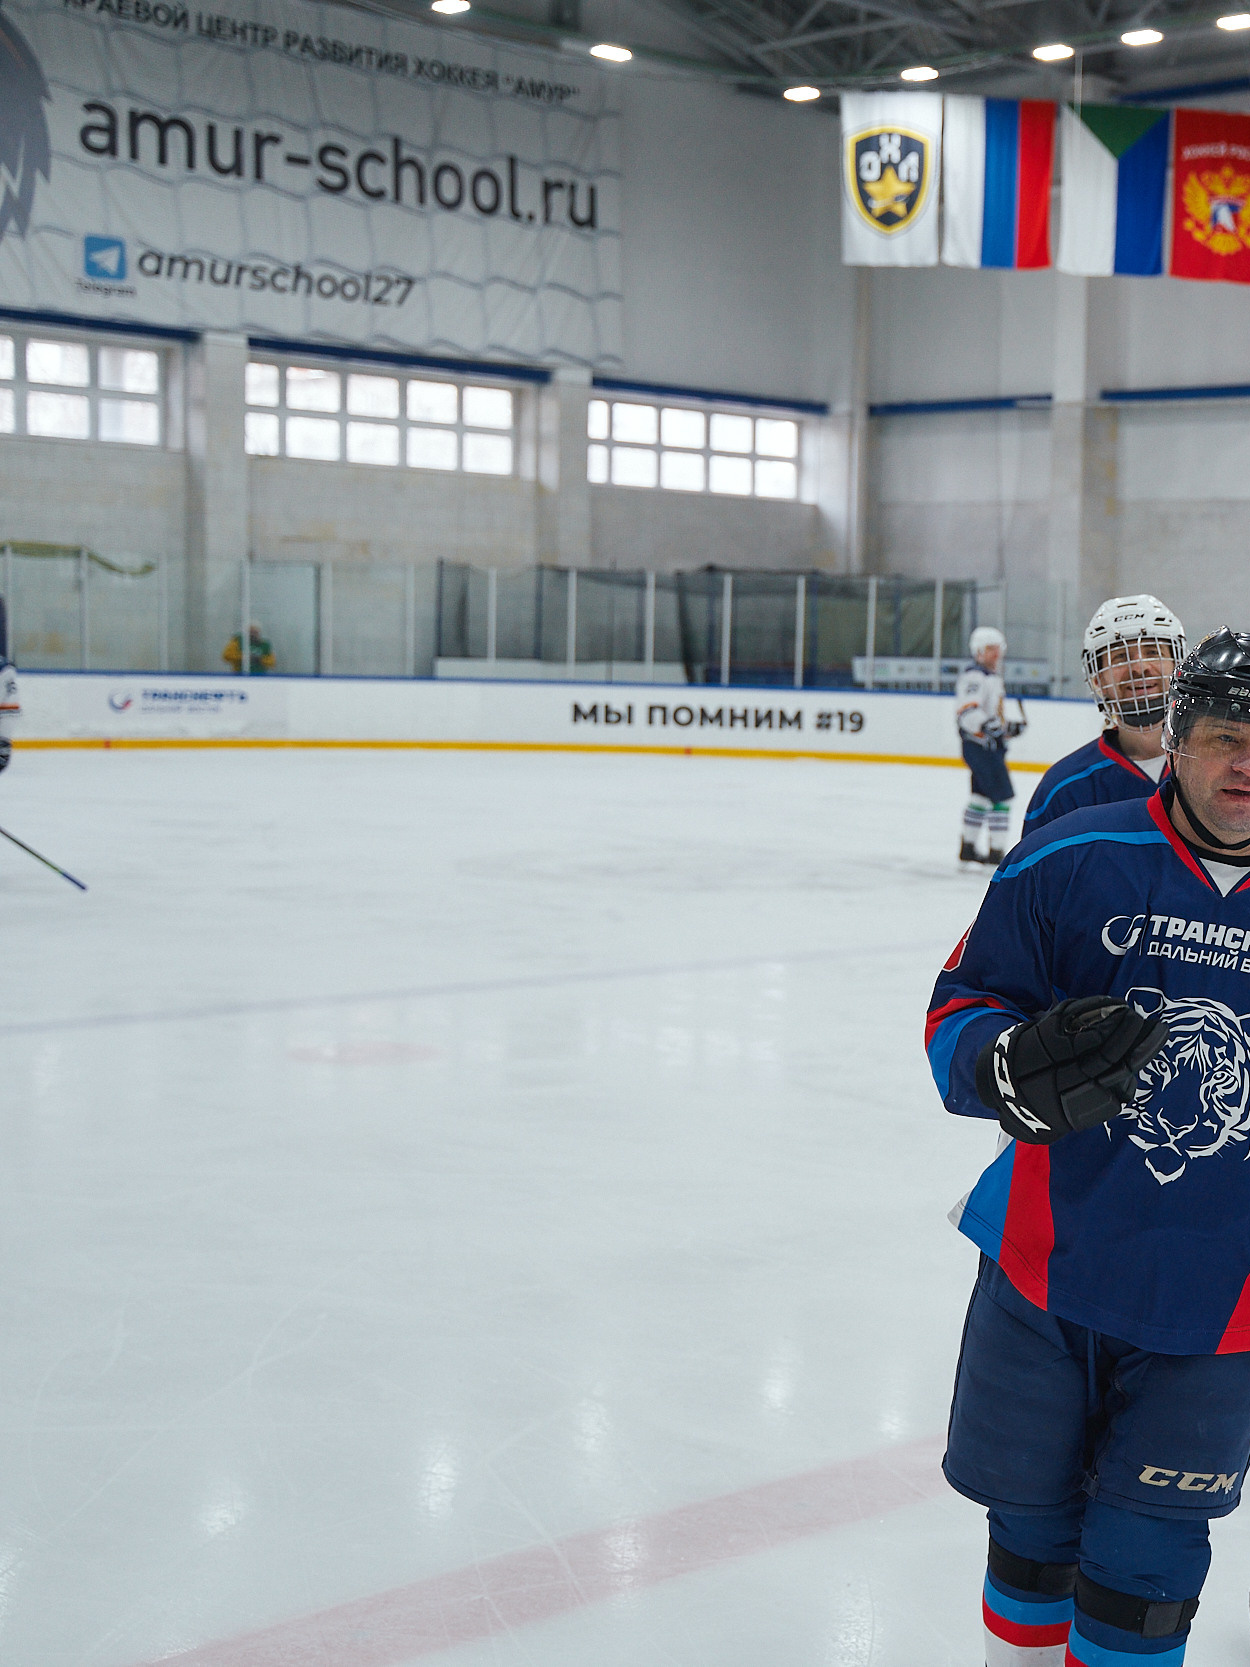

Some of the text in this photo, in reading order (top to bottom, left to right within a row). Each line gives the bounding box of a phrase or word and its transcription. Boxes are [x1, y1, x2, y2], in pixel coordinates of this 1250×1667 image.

[196, 13, 278, 48] ЦЕНТР
[283, 29, 408, 75] РАЗВИТИЯ
[413, 56, 498, 91] ХОККЕЯ
[79, 99, 600, 231] amur-school.ru
[137, 248, 416, 308] amurschool27
[1114, 613, 1145, 623] CCM
[571, 702, 865, 734] МЫ ПОМНИМ #19
[1146, 941, 1238, 971] ДАЛЬНИЙ
[1138, 1464, 1240, 1495] CCM
